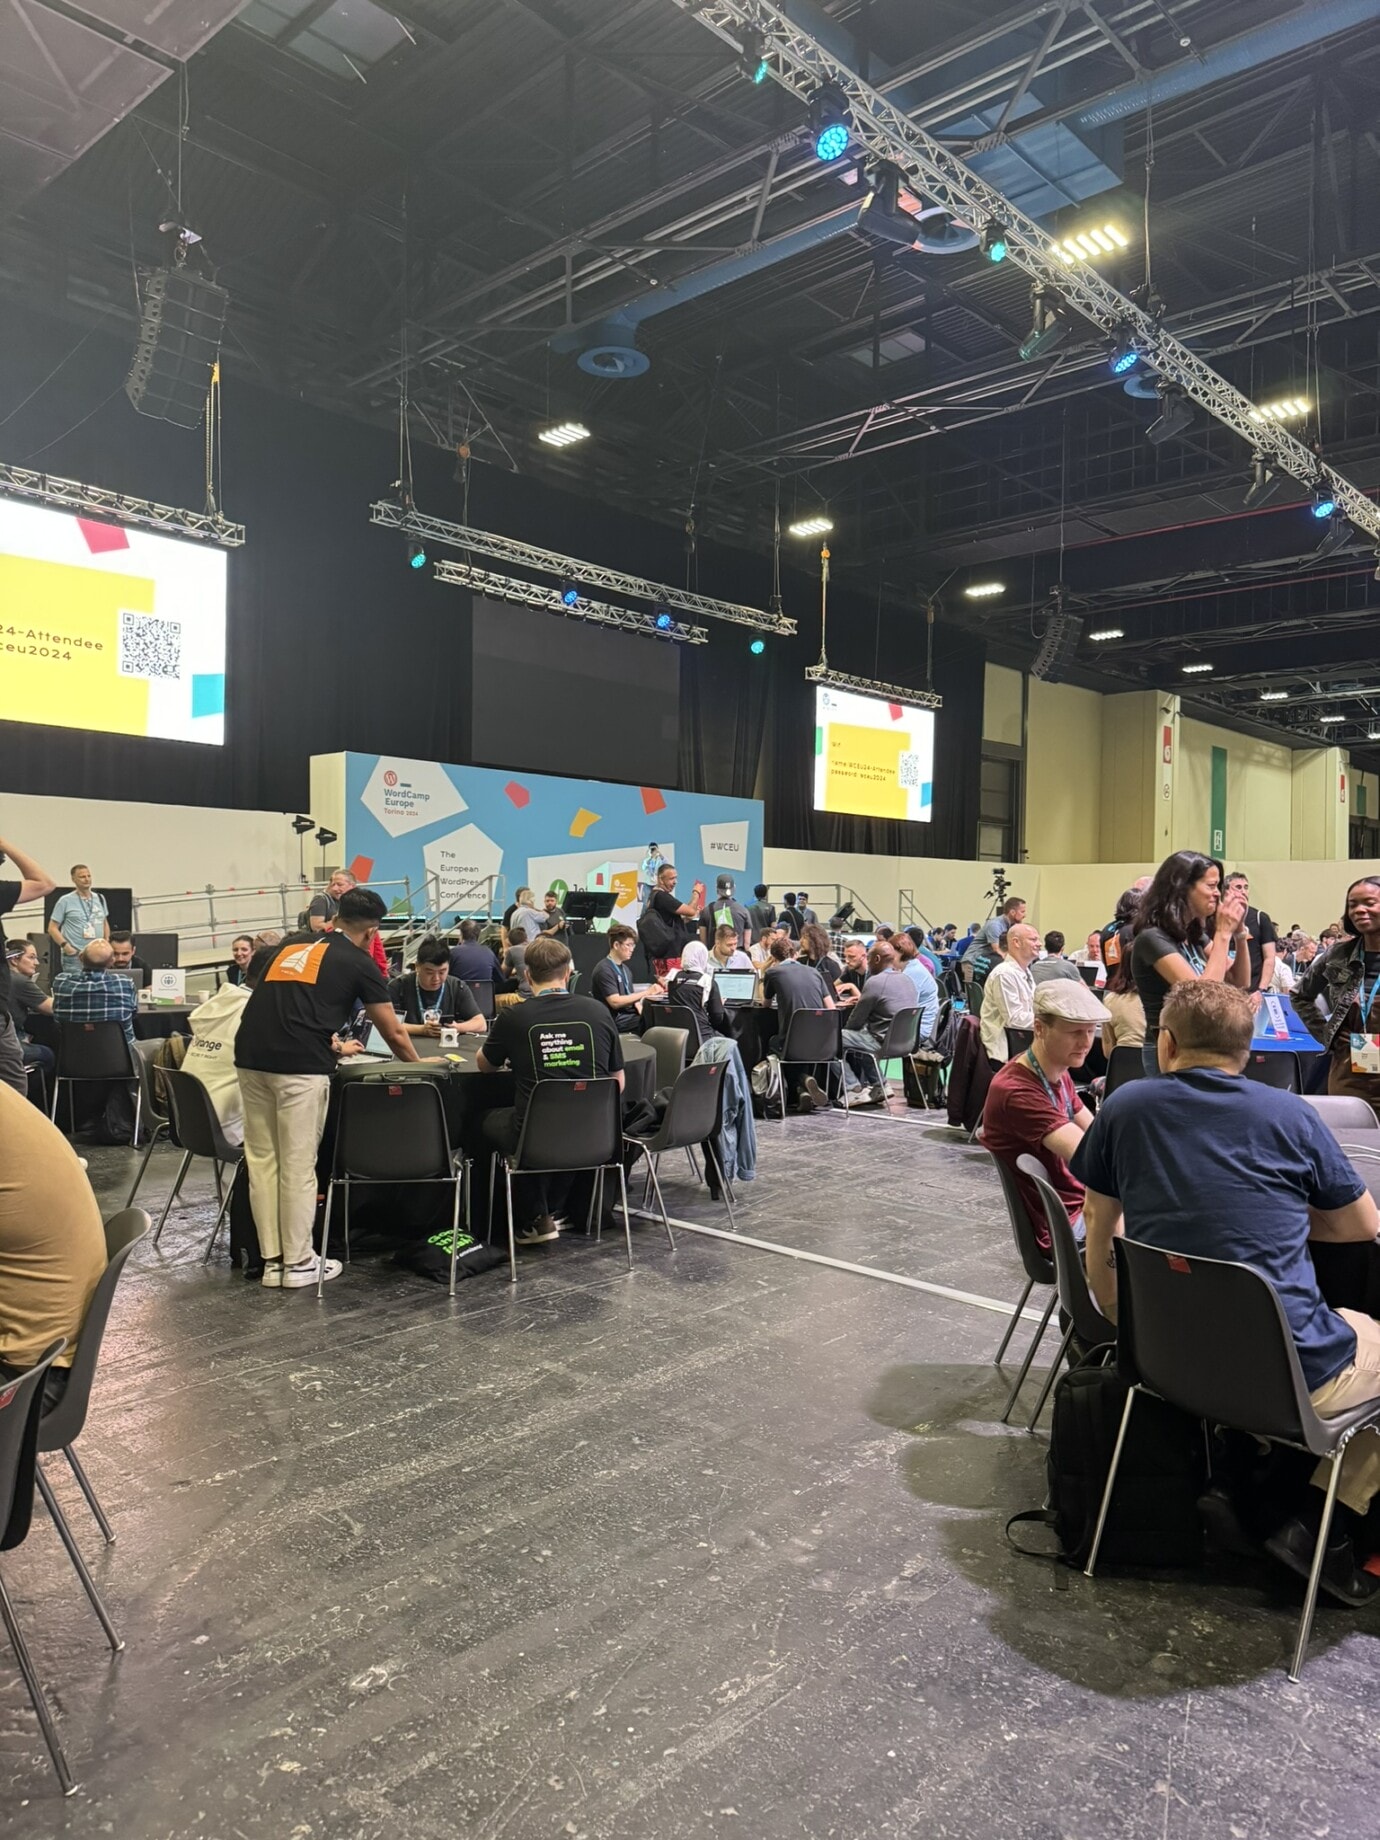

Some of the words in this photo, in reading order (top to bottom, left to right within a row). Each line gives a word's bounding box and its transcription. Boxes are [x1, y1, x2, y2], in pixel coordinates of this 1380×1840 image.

[383, 788, 430, 802] WordCamp
[385, 797, 414, 809] Europe
[384, 807, 404, 816] Torino
[710, 842, 740, 852] #WCEU
[440, 850, 456, 859] The
[440, 864, 479, 874] European
[540, 1032, 554, 1040] Ask
[540, 1039, 573, 1047] anything
[564, 1043, 585, 1051] email
[543, 1058, 581, 1068] marketing
